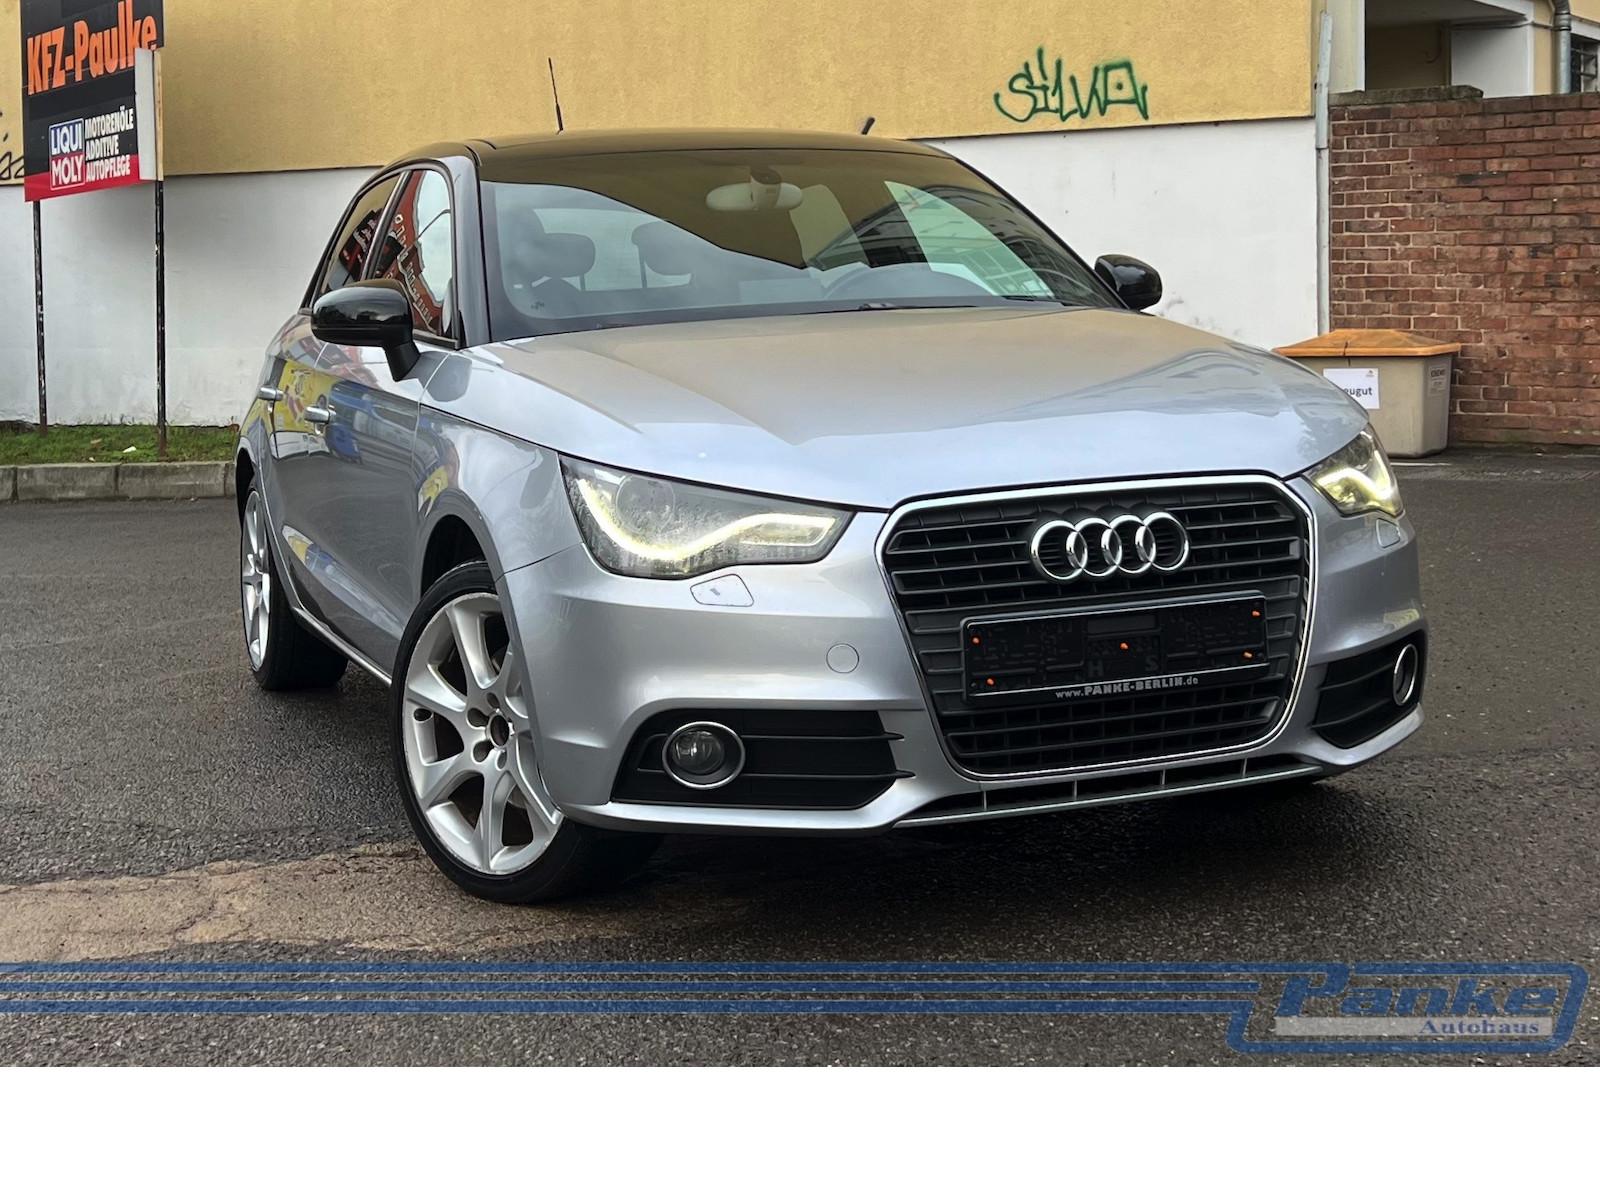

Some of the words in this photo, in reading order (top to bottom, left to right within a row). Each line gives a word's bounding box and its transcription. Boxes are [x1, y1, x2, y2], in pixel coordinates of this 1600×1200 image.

[27, 0, 157, 96] KFZ-Paulke
[85, 105, 134, 139] MOTORENÖLE
[51, 123, 82, 155] LIQUI
[86, 134, 119, 161] ADDITIVE
[52, 154, 84, 186] MOLY
[86, 154, 131, 182] AUTOPFLEGE
[1055, 676, 1199, 699] www.PANKE-BERLIN.de
